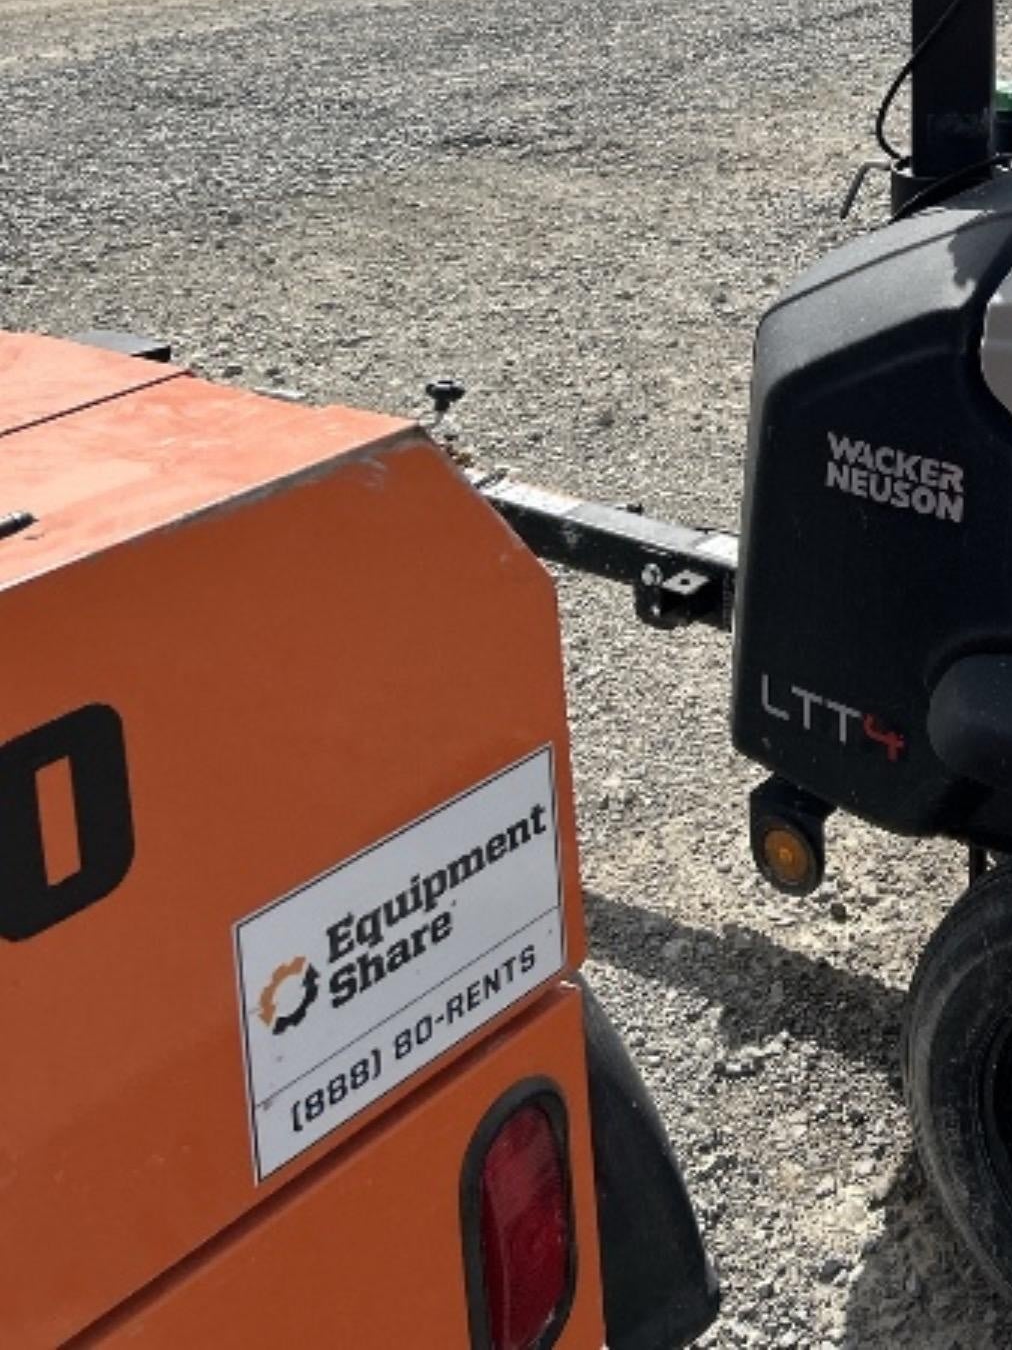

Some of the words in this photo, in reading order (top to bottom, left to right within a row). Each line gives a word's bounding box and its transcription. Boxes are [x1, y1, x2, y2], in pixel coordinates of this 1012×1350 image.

[824, 460, 964, 524] NEUSON
[826, 430, 965, 493] WACKER
[760, 673, 906, 763] LTT4
[326, 802, 547, 965] Equipment
[328, 911, 453, 1009] Share
[290, 1047, 382, 1132] (888)
[393, 944, 536, 1060] 80-RENTS
